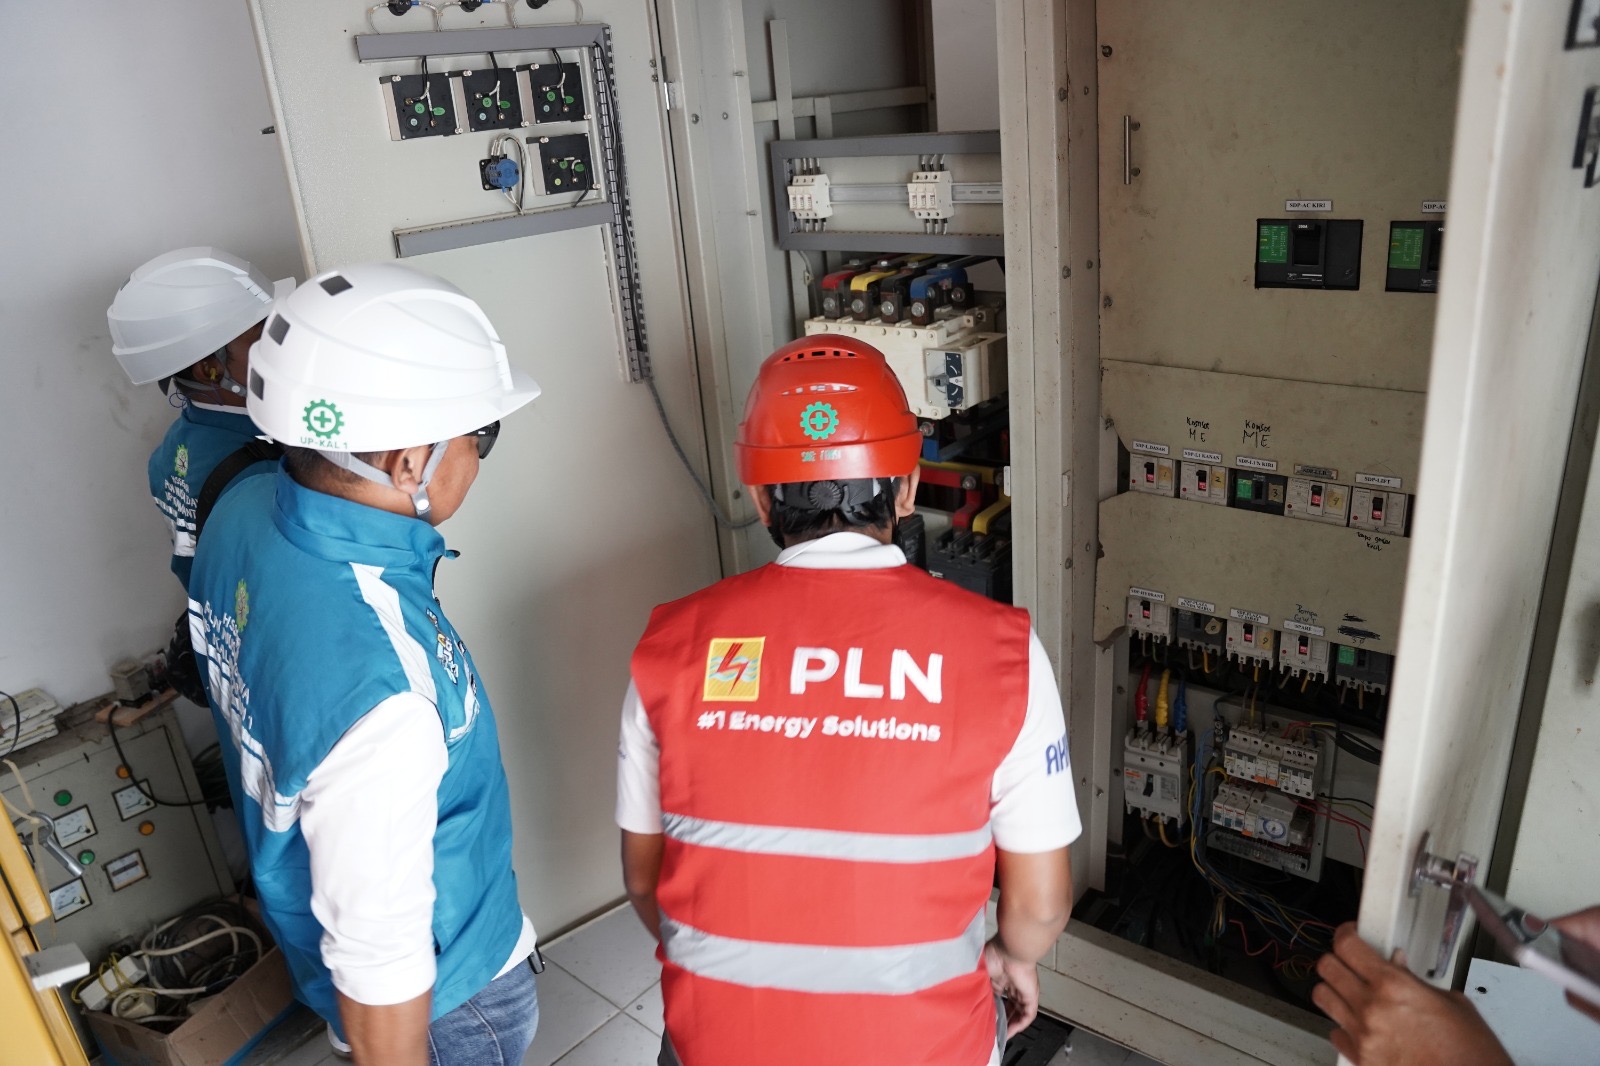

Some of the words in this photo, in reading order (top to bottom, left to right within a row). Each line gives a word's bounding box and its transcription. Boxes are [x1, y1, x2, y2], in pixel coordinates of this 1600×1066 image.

[1272, 488, 1279, 498] 3
[789, 646, 943, 704] PLN
[697, 710, 726, 730] #1
[729, 712, 818, 739] Energy
[821, 714, 941, 742] Solutions
